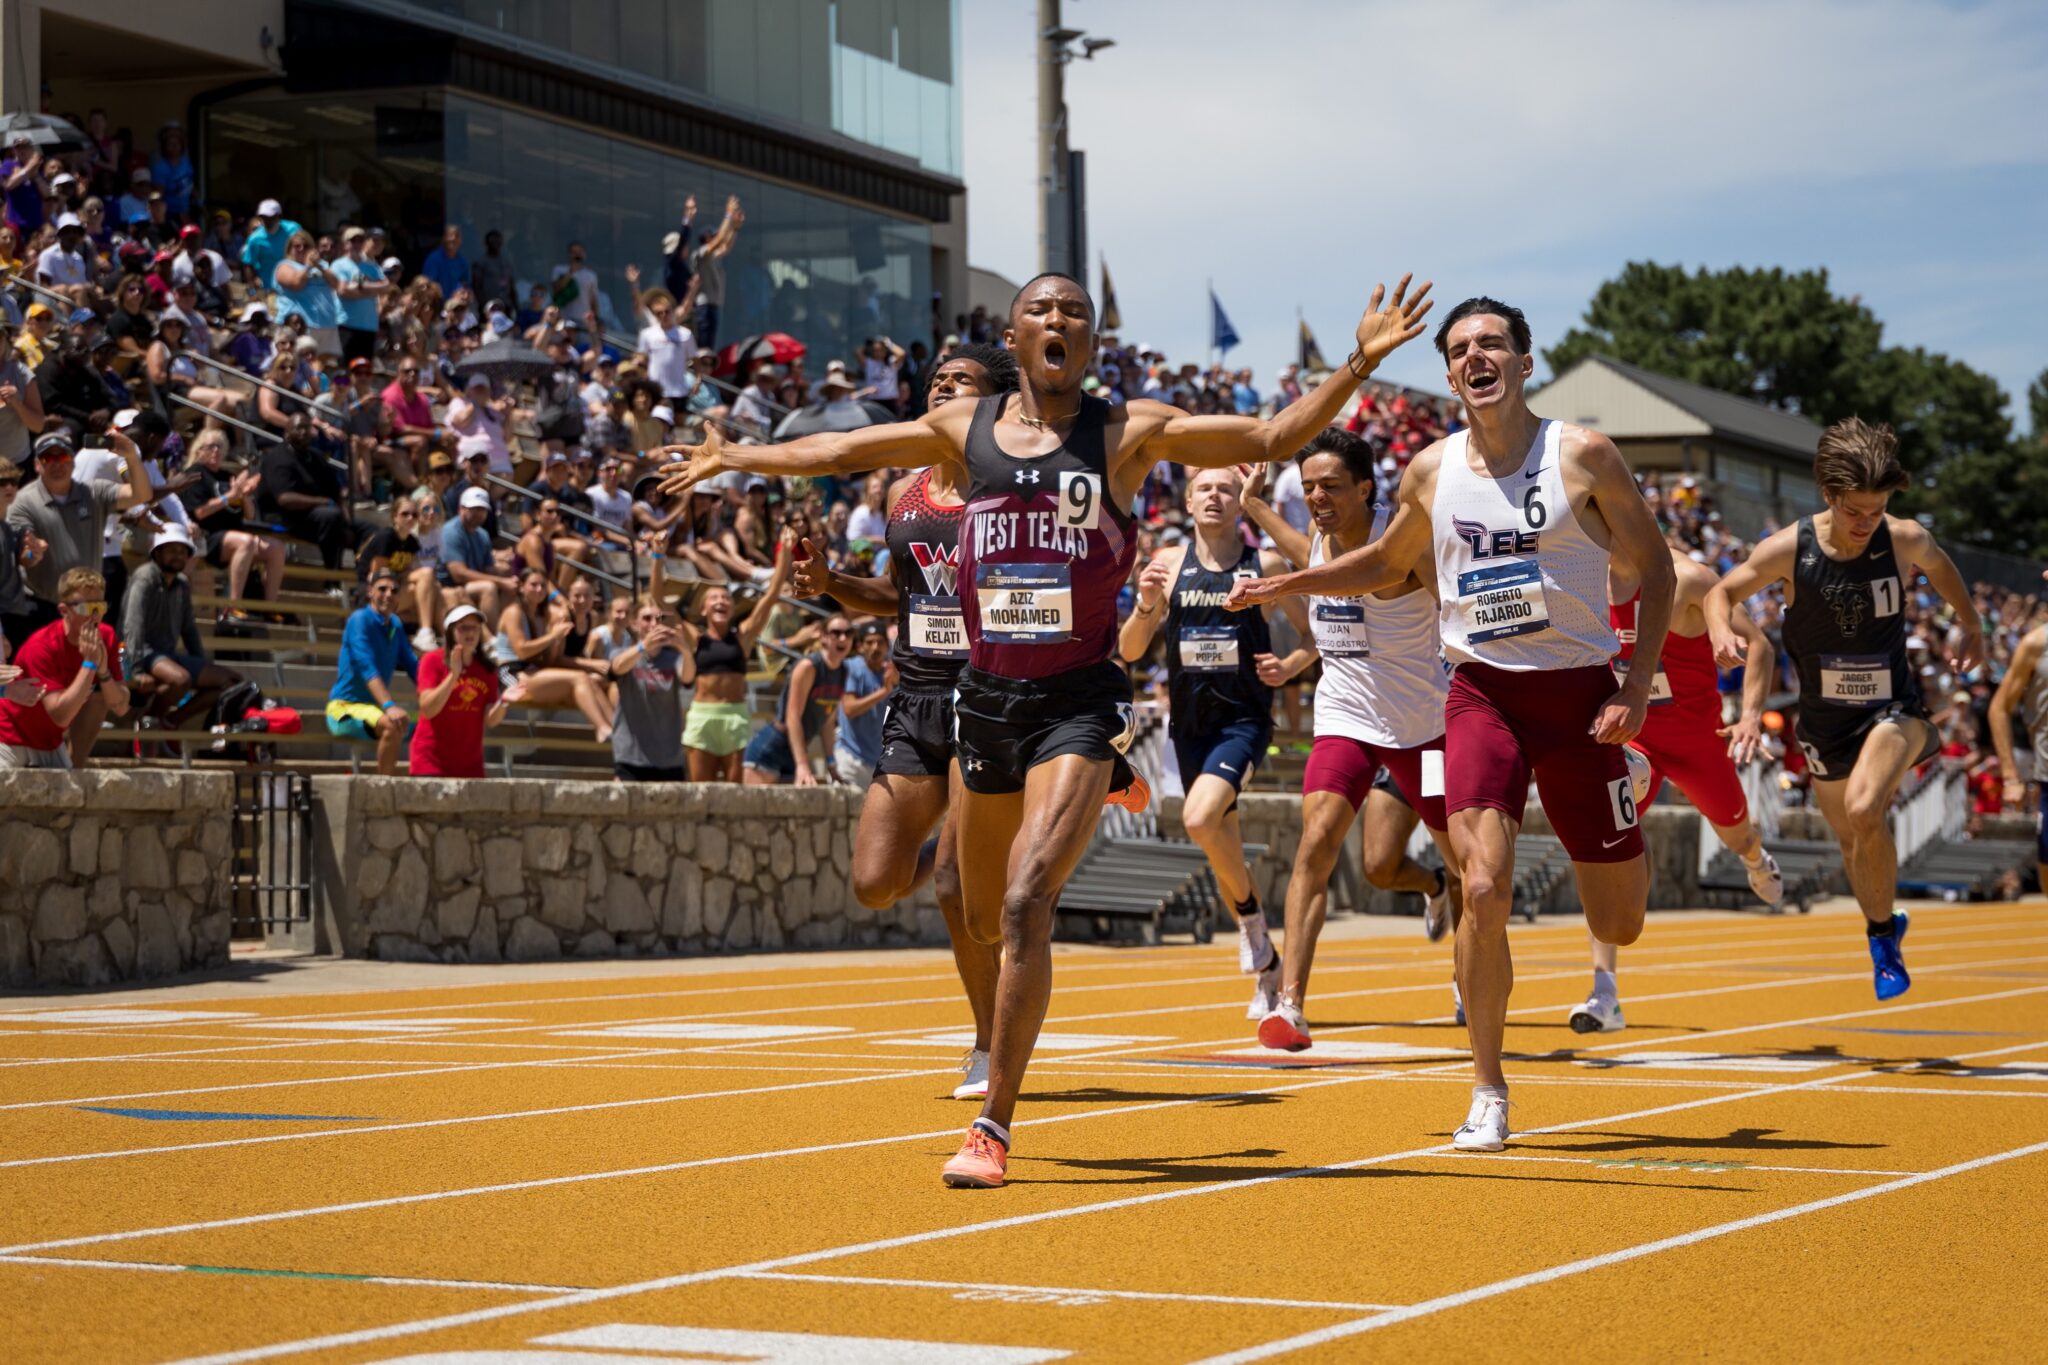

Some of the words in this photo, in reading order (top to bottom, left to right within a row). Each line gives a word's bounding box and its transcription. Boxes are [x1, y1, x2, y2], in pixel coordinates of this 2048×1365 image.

[1067, 475, 1093, 525] 9
[1523, 485, 1547, 529] 6
[974, 511, 1019, 561] WEST
[1027, 511, 1088, 560] TEXAS
[1456, 518, 1540, 561] LEE
[1010, 592, 1034, 605] AZIZ
[1179, 589, 1229, 608] WING
[1477, 587, 1522, 607] ROBERTO
[1880, 580, 1892, 613] 1
[990, 609, 1060, 625] MOHAMED
[1475, 601, 1532, 626] FAJARDO
[927, 617, 955, 628] SIMON
[1327, 624, 1350, 634] JUAN
[925, 630, 960, 644] KELATI
[1336, 640, 1368, 648] CASTRO
[1196, 652, 1223, 662] POPPE
[1840, 673, 1873, 682] JAGGER
[1835, 683, 1878, 695] ZLOTOFF
[1618, 780, 1635, 825] 6
